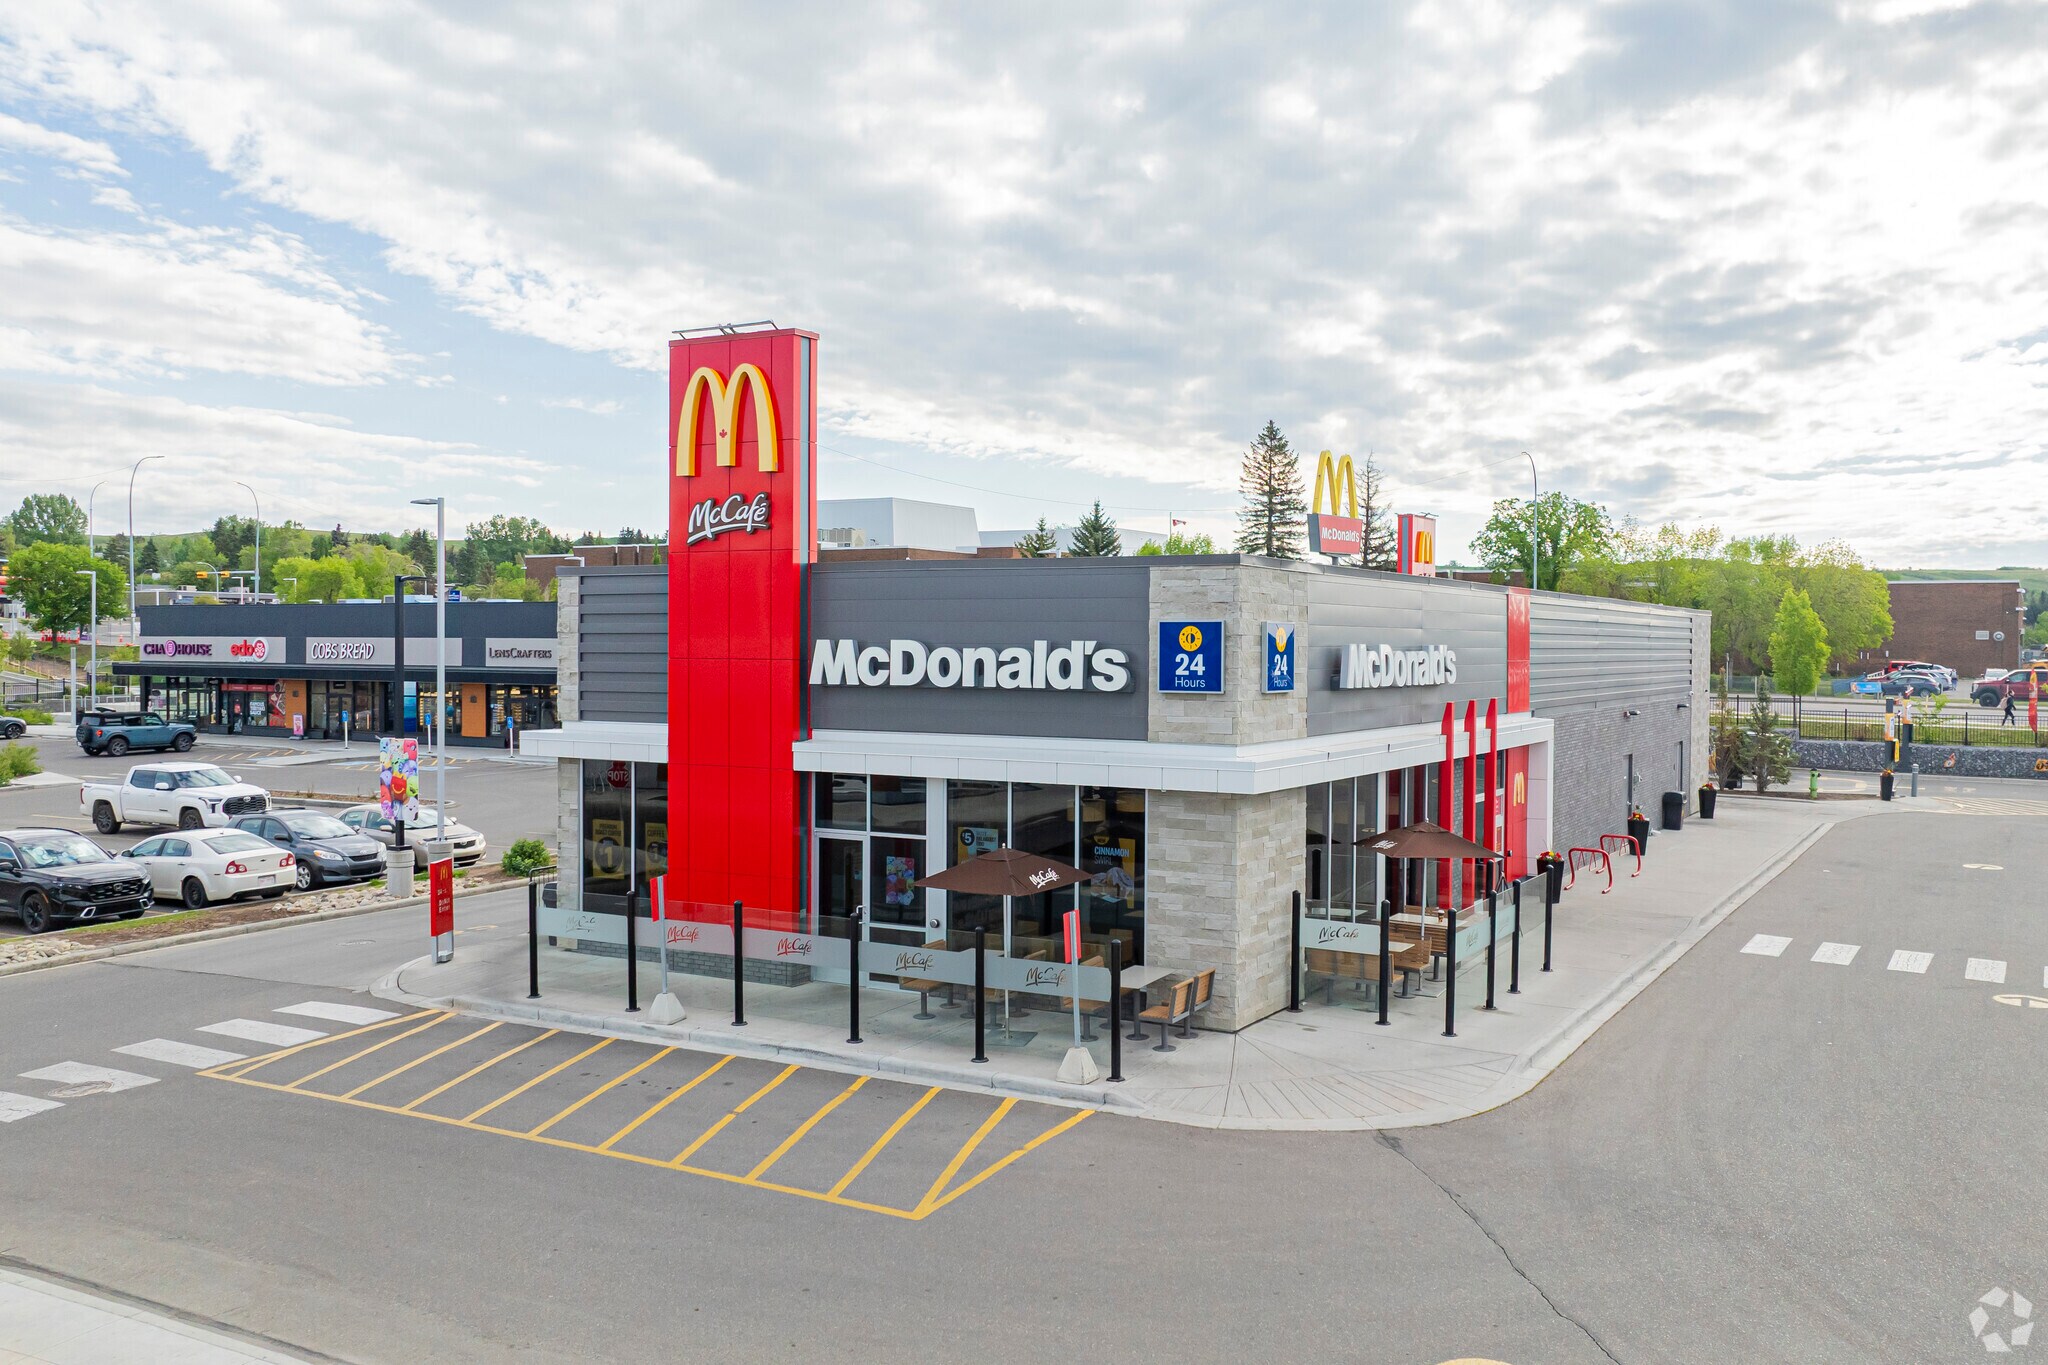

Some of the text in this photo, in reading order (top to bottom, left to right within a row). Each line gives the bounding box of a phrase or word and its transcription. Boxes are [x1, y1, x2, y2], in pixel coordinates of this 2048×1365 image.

[686, 492, 770, 545] McCafé
[1321, 527, 1360, 543] McDonald's
[143, 643, 213, 656] CHA HOUSE
[230, 639, 256, 656] edo
[311, 642, 375, 660] COBS BREAD
[809, 639, 1130, 692] McDonald's
[1175, 653, 1206, 676] 24
[1274, 654, 1288, 676] 24
[1342, 643, 1457, 689] McDonald's
[1174, 676, 1206, 688] Hours
[1273, 677, 1288, 687] Hours
[1094, 846, 1130, 857] CINNAMON
[1094, 855, 1113, 866] SWIRL
